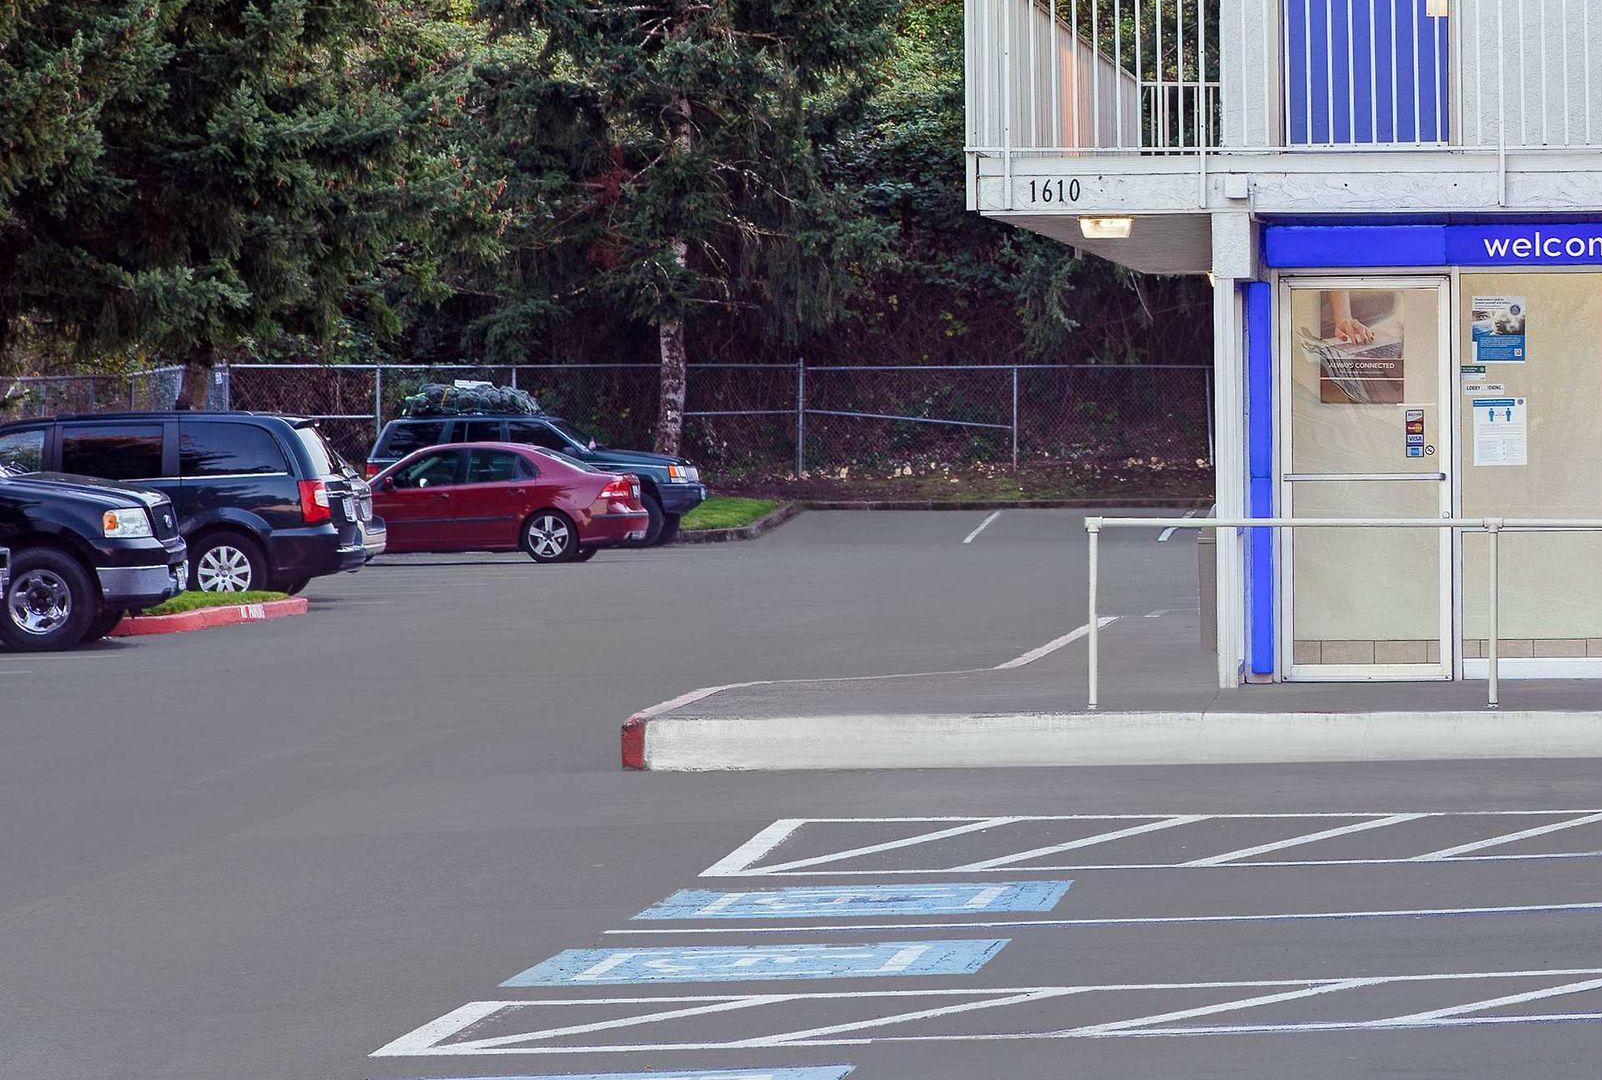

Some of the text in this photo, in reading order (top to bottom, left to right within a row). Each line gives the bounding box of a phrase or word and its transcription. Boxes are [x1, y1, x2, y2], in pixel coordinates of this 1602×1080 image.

[1029, 178, 1081, 203] 1610
[1328, 361, 1395, 369] ALWAYS CONNECTED
